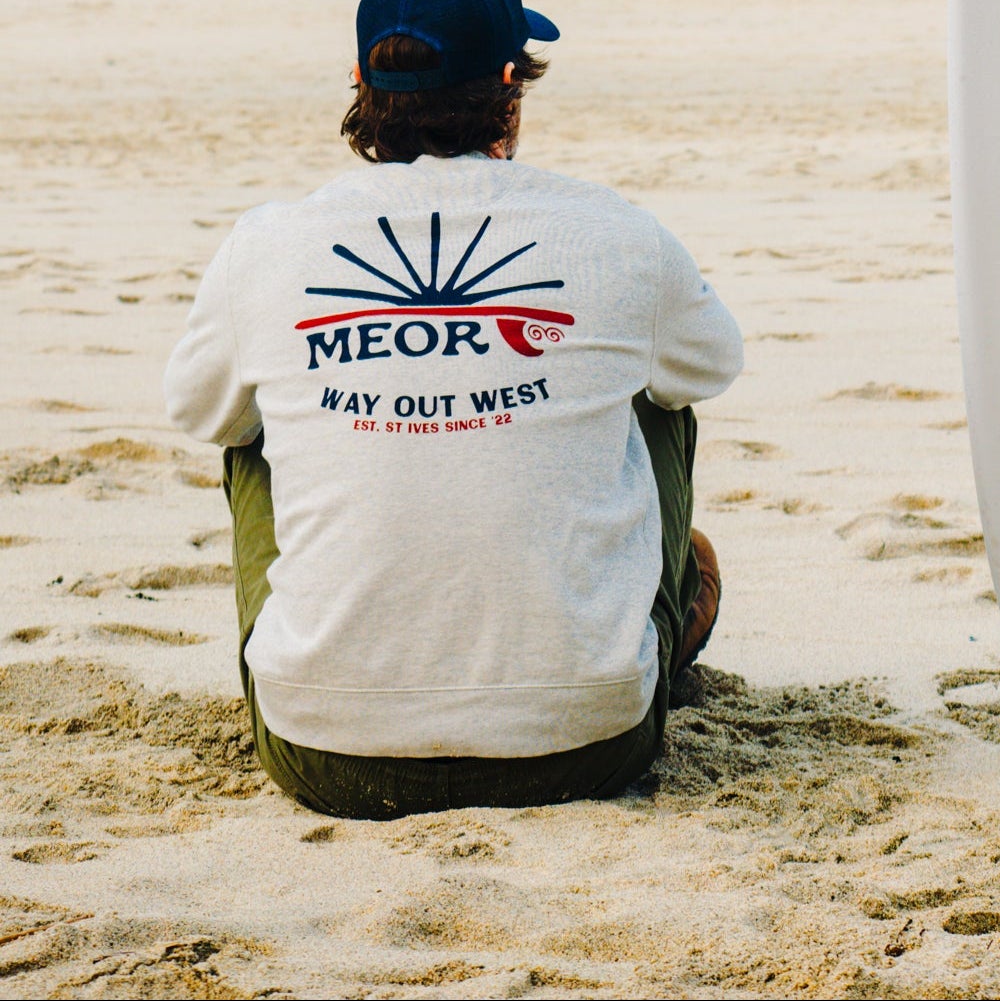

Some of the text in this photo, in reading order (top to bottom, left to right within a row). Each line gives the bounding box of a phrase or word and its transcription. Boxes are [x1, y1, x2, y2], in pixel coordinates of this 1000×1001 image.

[306, 320, 490, 370] MEOR
[320, 377, 550, 419] WAY OUT WEST
[353, 419, 380, 432] EST.
[385, 421, 402, 433] ST
[408, 422, 439, 434] IVES
[445, 417, 487, 432] SINCE
